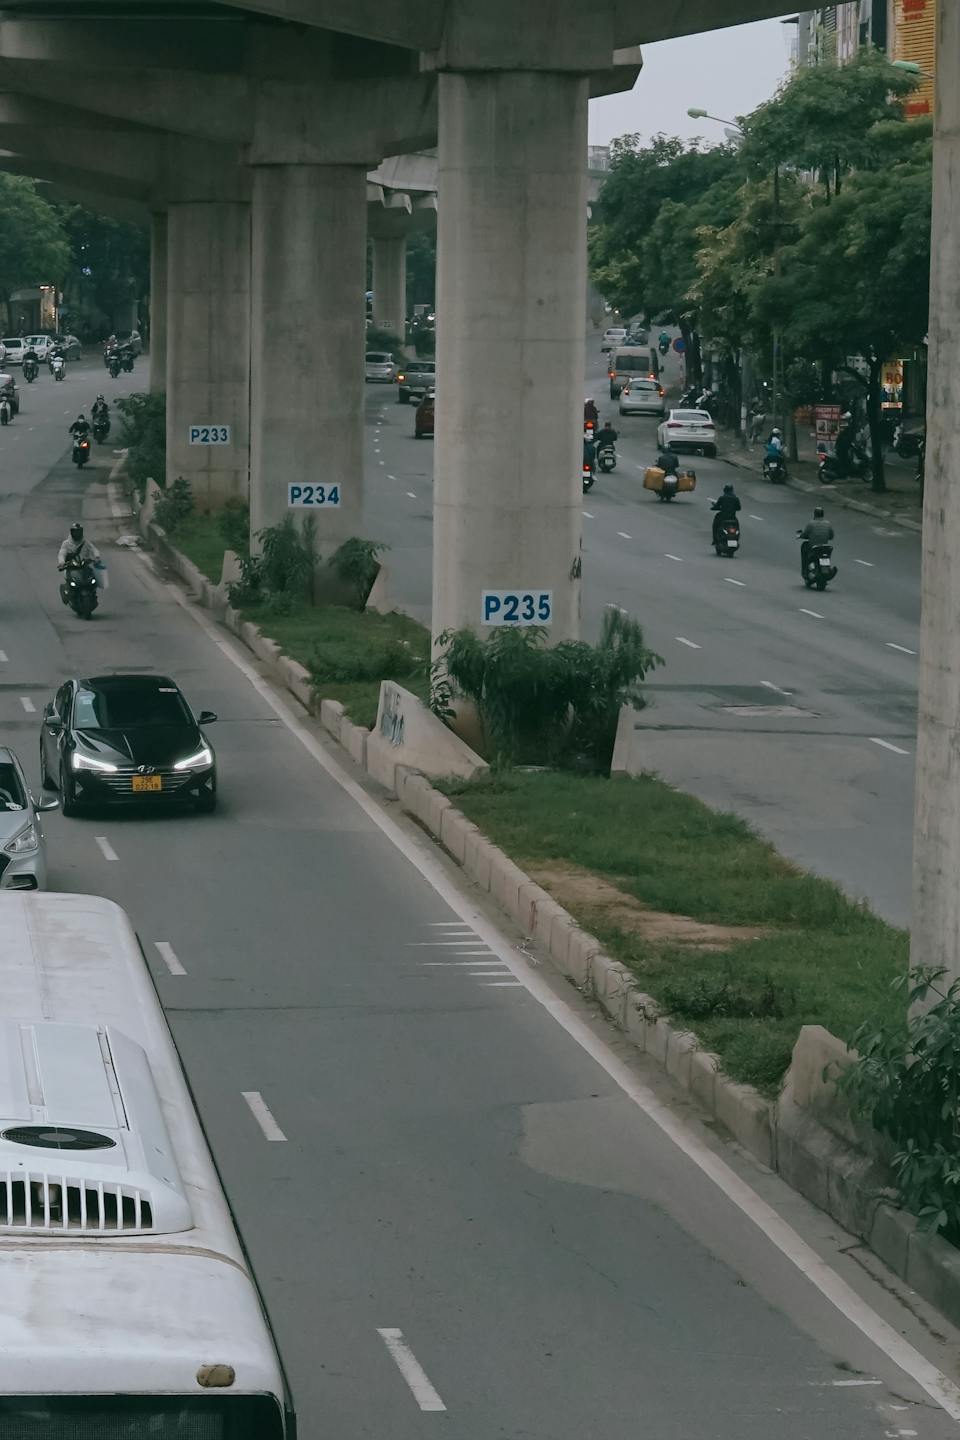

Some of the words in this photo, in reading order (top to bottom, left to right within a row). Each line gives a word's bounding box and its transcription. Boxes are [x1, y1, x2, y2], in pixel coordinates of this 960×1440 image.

[191, 428, 228, 442] P233
[291, 486, 339, 504] P234
[485, 594, 550, 621] P235
